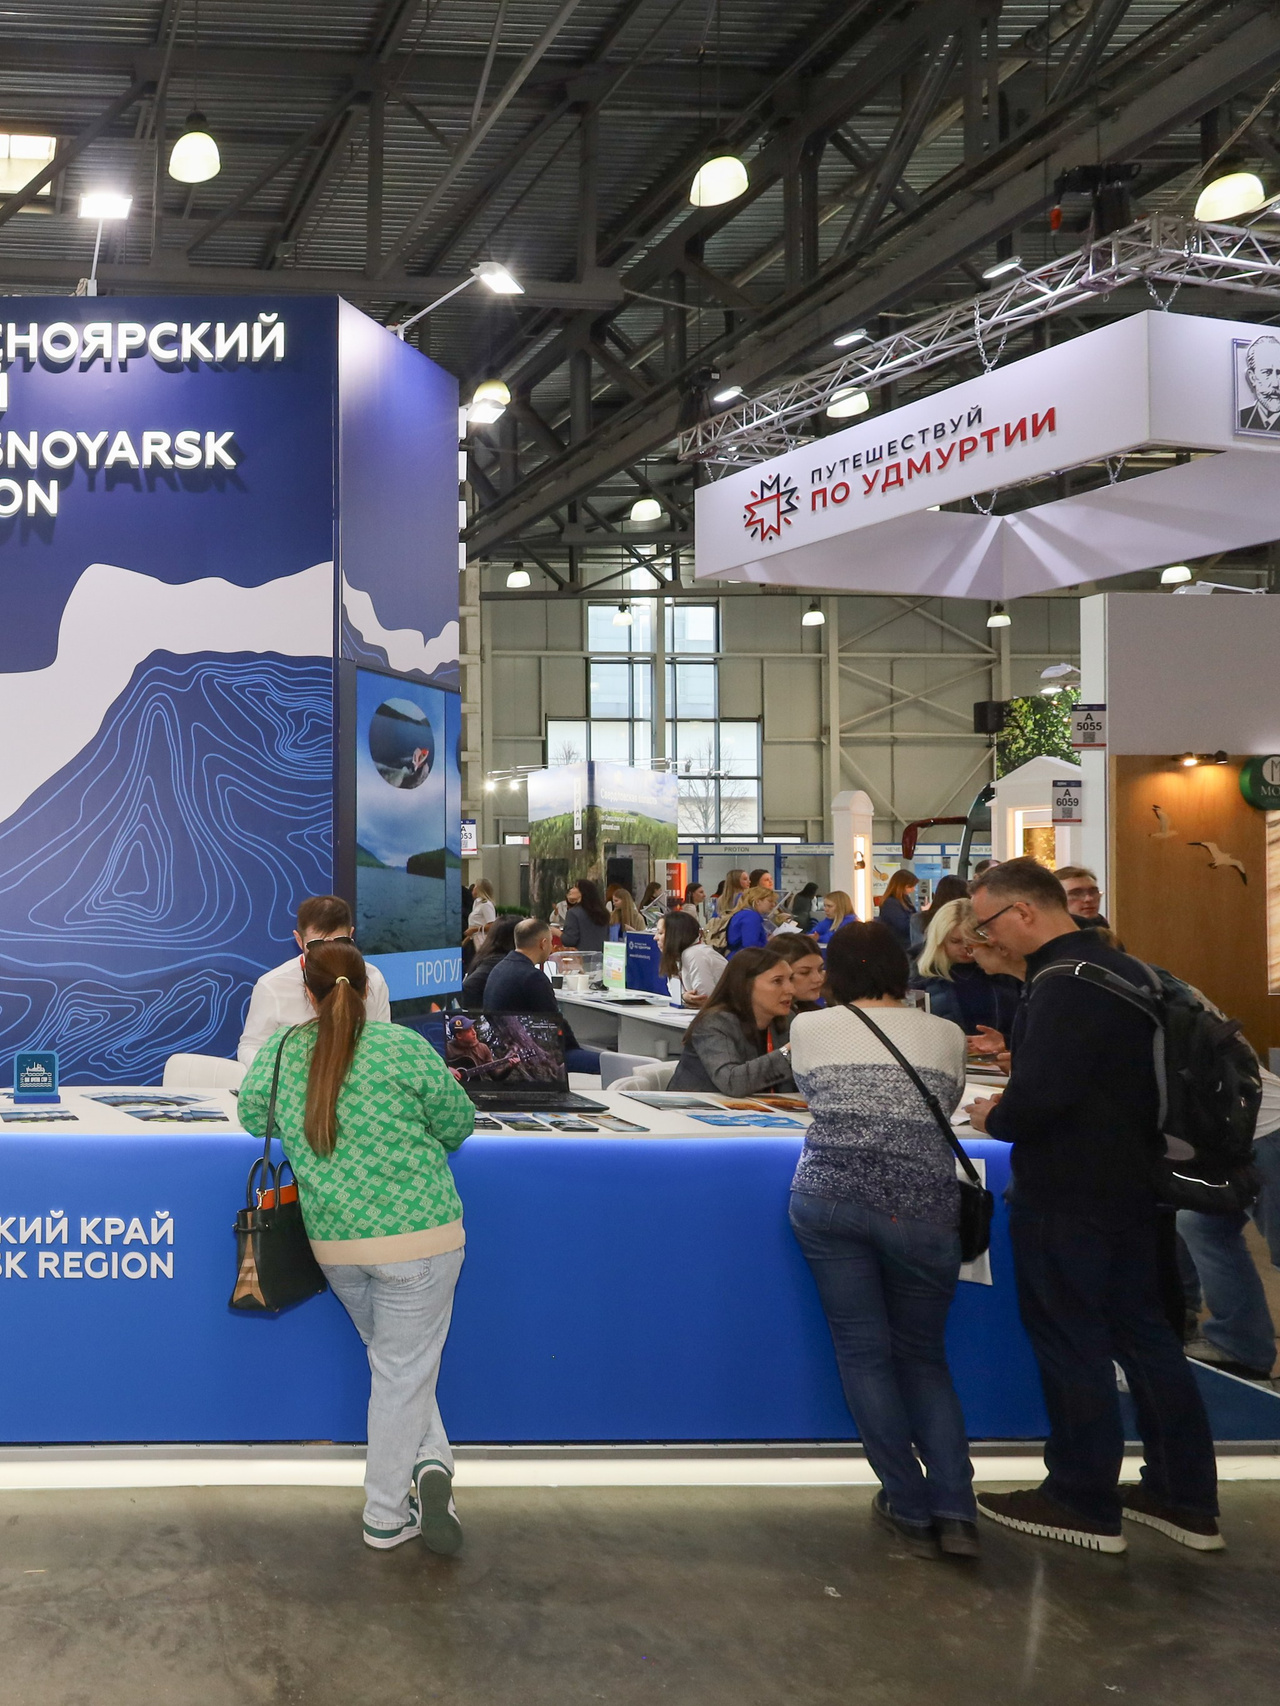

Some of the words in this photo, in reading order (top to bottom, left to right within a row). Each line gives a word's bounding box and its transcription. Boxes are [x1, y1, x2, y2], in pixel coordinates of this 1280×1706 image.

[811, 405, 983, 485] ПУТЕШЕСТВУЙ
[811, 482, 851, 511] ПО
[862, 407, 1056, 496] УДМУРТИИ
[1076, 722, 1102, 731] 5055
[1056, 797, 1079, 807] 6059
[80, 1210, 174, 1245] КРАЙ
[38, 1251, 174, 1279] REGION
